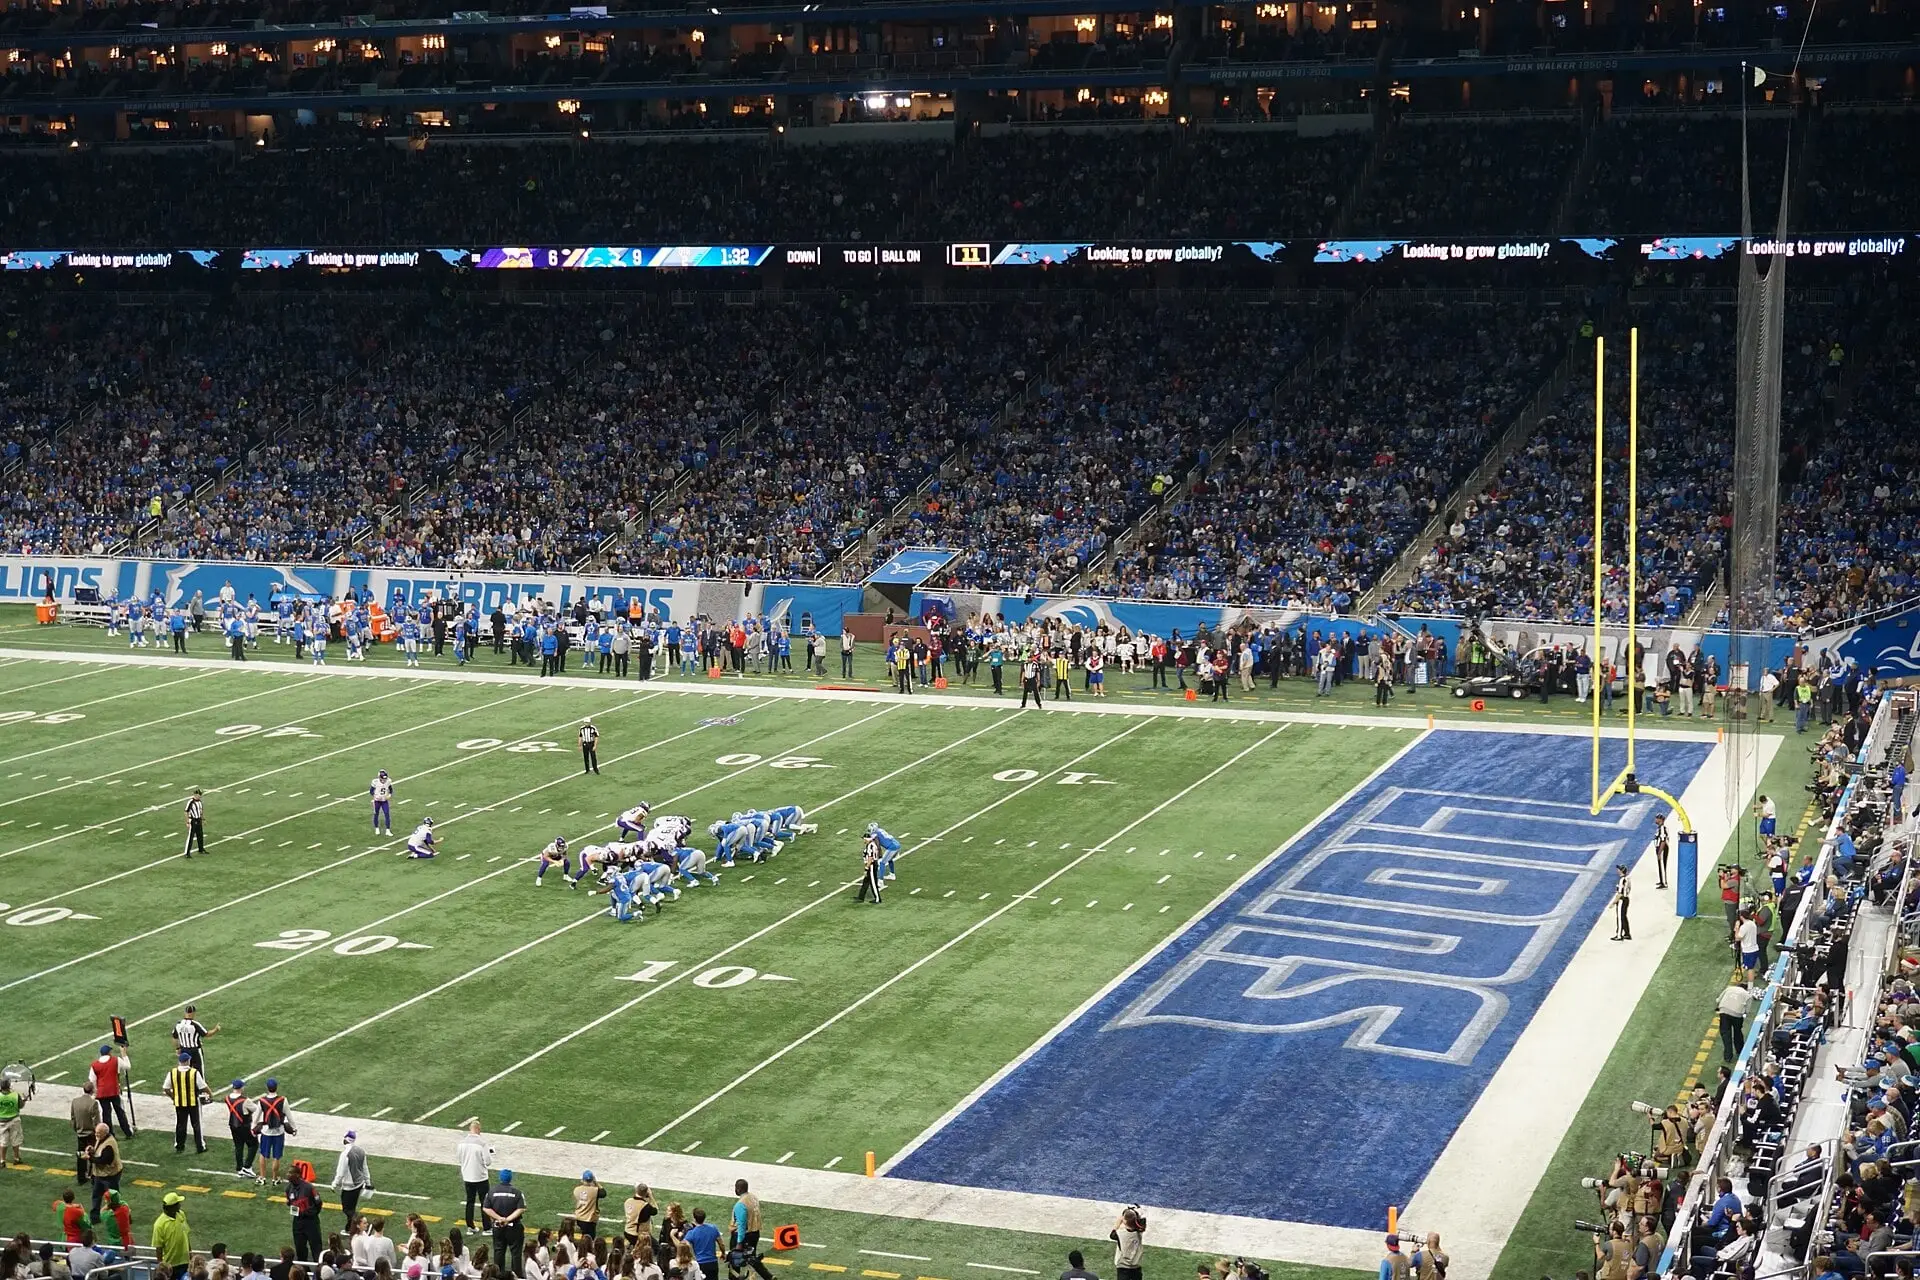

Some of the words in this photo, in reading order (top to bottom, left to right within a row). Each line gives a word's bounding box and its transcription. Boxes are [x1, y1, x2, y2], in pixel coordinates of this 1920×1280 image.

[1817, 52, 1857, 61] BARNEY
[1210, 70, 1249, 79] HERMAN
[1251, 69, 1283, 78] MOORE
[1537, 61, 1576, 70] WALKER
[961, 248, 980, 262] 11
[1087, 247, 1130, 263] Looking
[1131, 247, 1143, 260] to
[1145, 248, 1173, 262] grow
[1175, 246, 1223, 262] globally?
[1403, 244, 1449, 260] Looking
[1450, 244, 1463, 258] to
[1465, 245, 1495, 260] grow
[1498, 243, 1550, 260] globally?
[1746, 240, 1795, 256] Looking
[1797, 240, 1811, 254] to
[1813, 241, 1846, 256] grow
[1848, 239, 1905, 255] globally?
[69, 254, 101, 268] Looking
[102, 255, 111, 265] to
[112, 256, 134, 268] grow
[135, 254, 172, 267] globally?
[308, 253, 343, 267] Looking
[344, 253, 355, 265] to
[356, 255, 379, 267] grow
[380, 252, 419, 267] globally?
[548, 249, 559, 266] 6
[632, 248, 643, 266] 9
[721, 248, 750, 265] 1:32
[787, 251, 815, 263] DOWN
[844, 251, 857, 263] TO
[858, 251, 871, 263] GO
[882, 251, 905, 263] BALL
[906, 250, 920, 263] ON
[1474, 700, 1484, 711] G
[0, 903, 73, 926] 0
[1100, 785, 1660, 1066] LIONS
[253, 929, 399, 956] 20
[613, 960, 758, 989] 10
[779, 1227, 798, 1248] G
